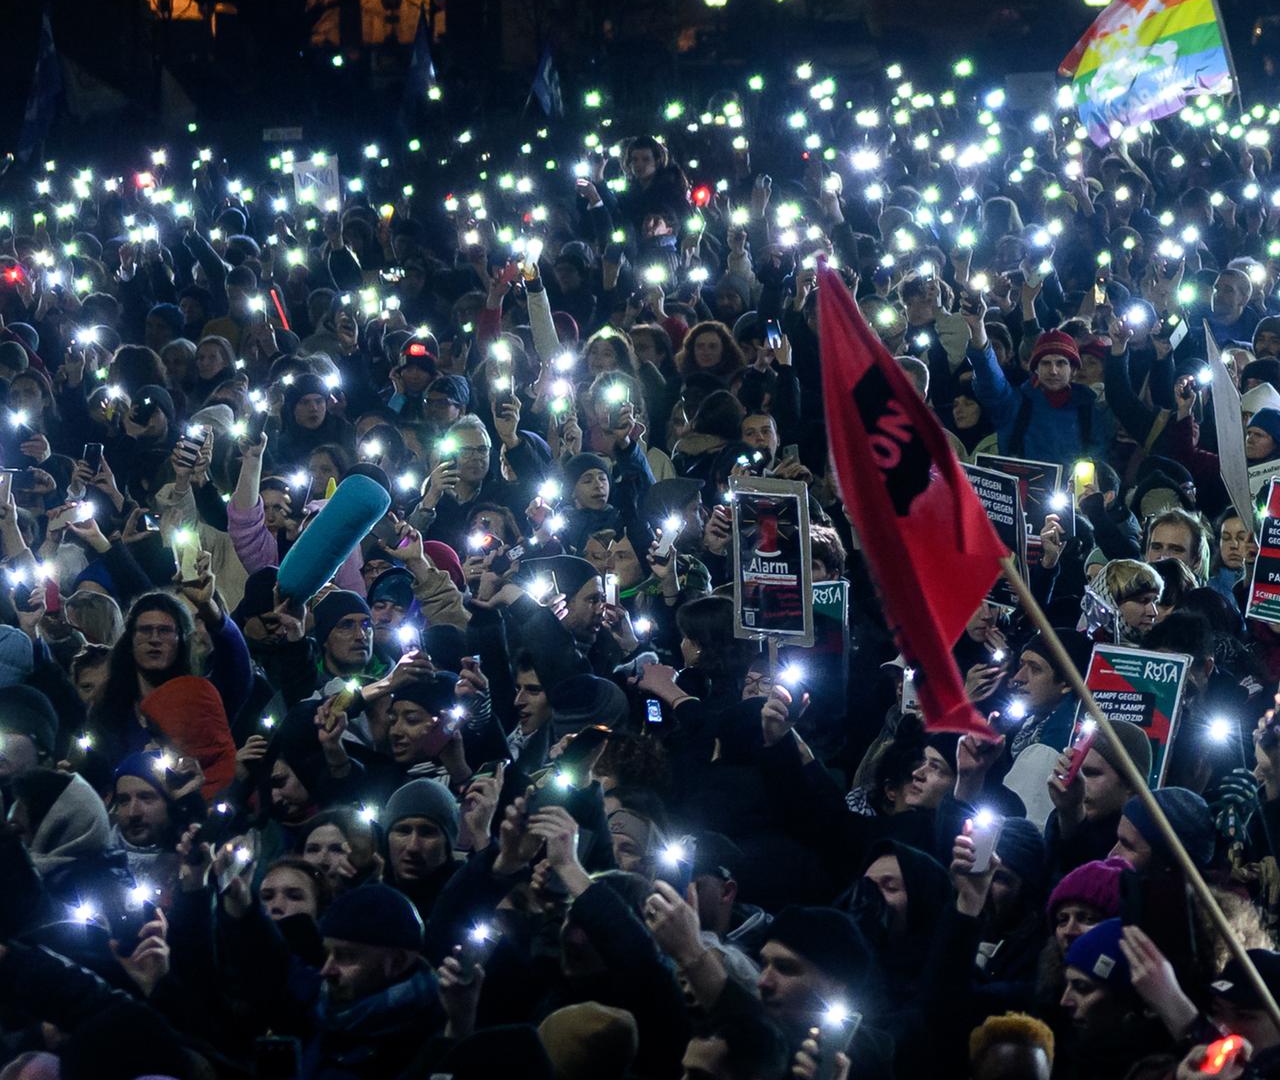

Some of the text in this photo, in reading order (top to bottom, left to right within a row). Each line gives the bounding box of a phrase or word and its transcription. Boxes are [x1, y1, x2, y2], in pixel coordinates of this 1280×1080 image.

[749, 558, 789, 574] Alarm
[1092, 692, 1143, 701] KAMPF GEGEN
[1120, 703, 1146, 712] KAMPF
[1110, 714, 1144, 722] GENOZID
